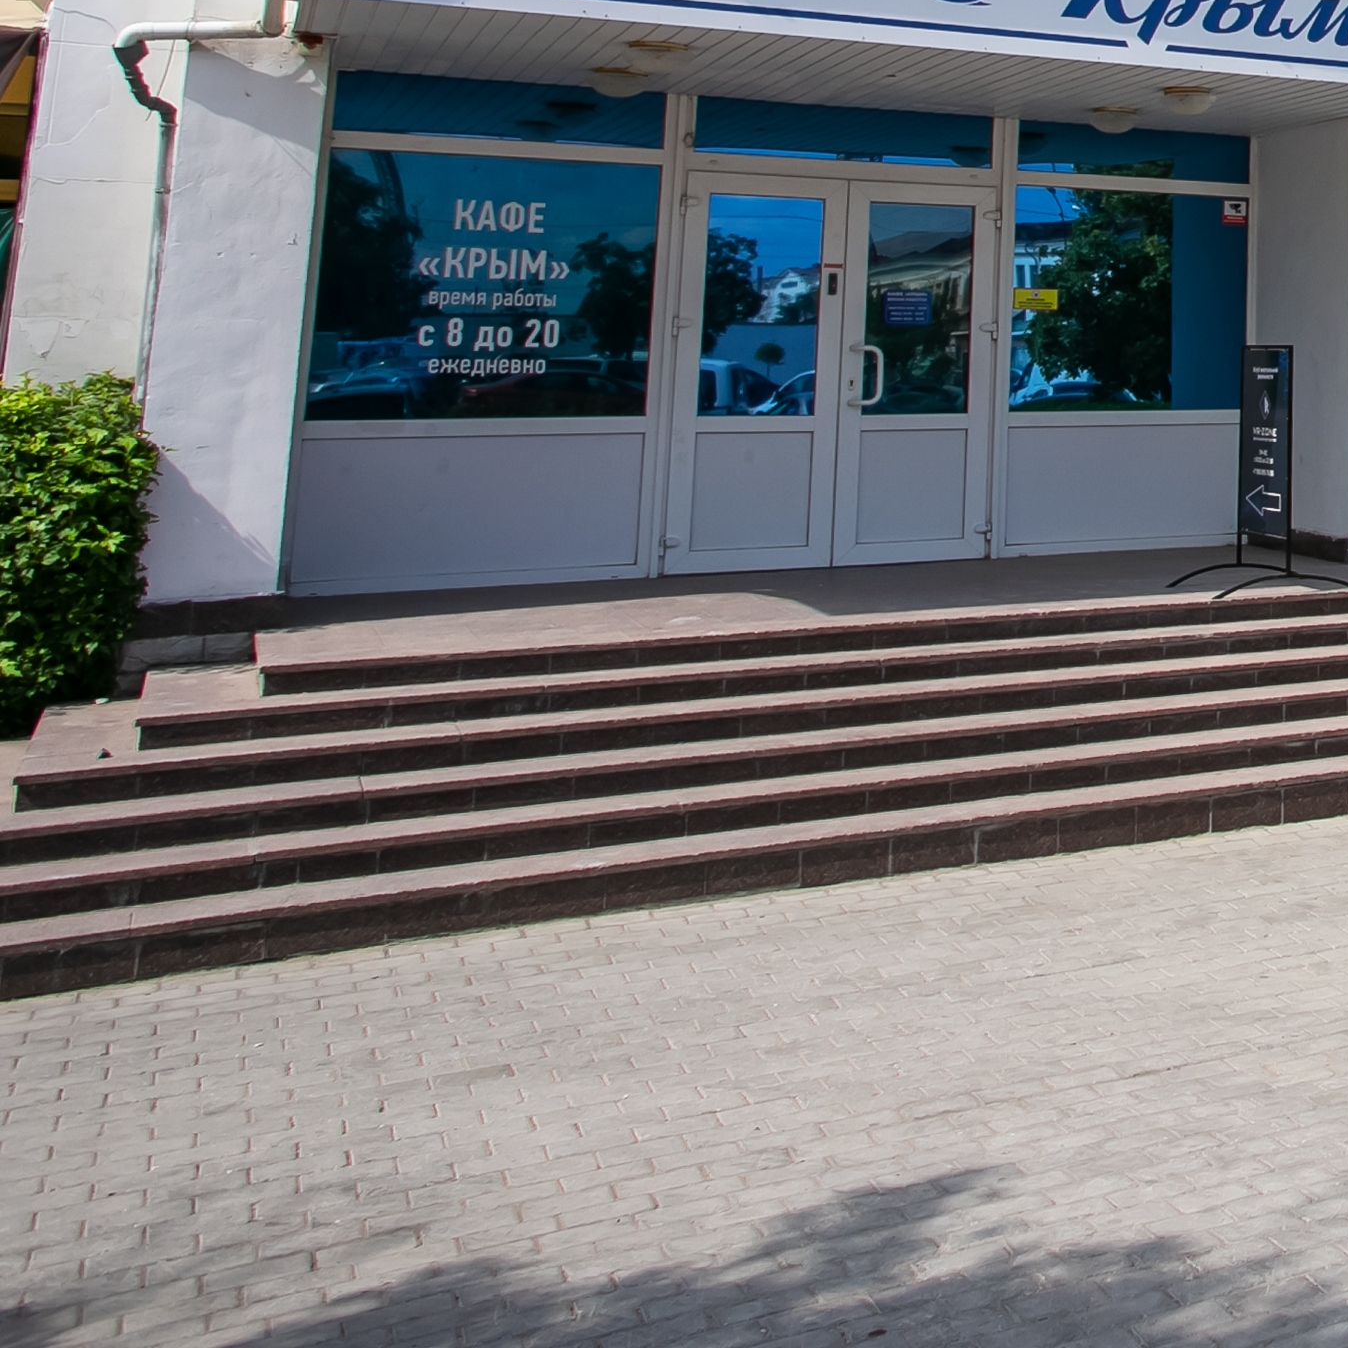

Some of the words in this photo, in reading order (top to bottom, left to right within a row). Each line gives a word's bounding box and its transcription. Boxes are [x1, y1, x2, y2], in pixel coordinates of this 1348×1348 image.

[454, 199, 546, 234] КАФЕ
[418, 247, 570, 281] «КРЫМ»
[428, 290, 486, 309] время
[491, 288, 557, 310] работы
[418, 324, 435, 347] с
[446, 317, 464, 347] 8
[473, 325, 513, 352] до
[524, 319, 560, 348] 20
[427, 358, 547, 377] ежедневно
